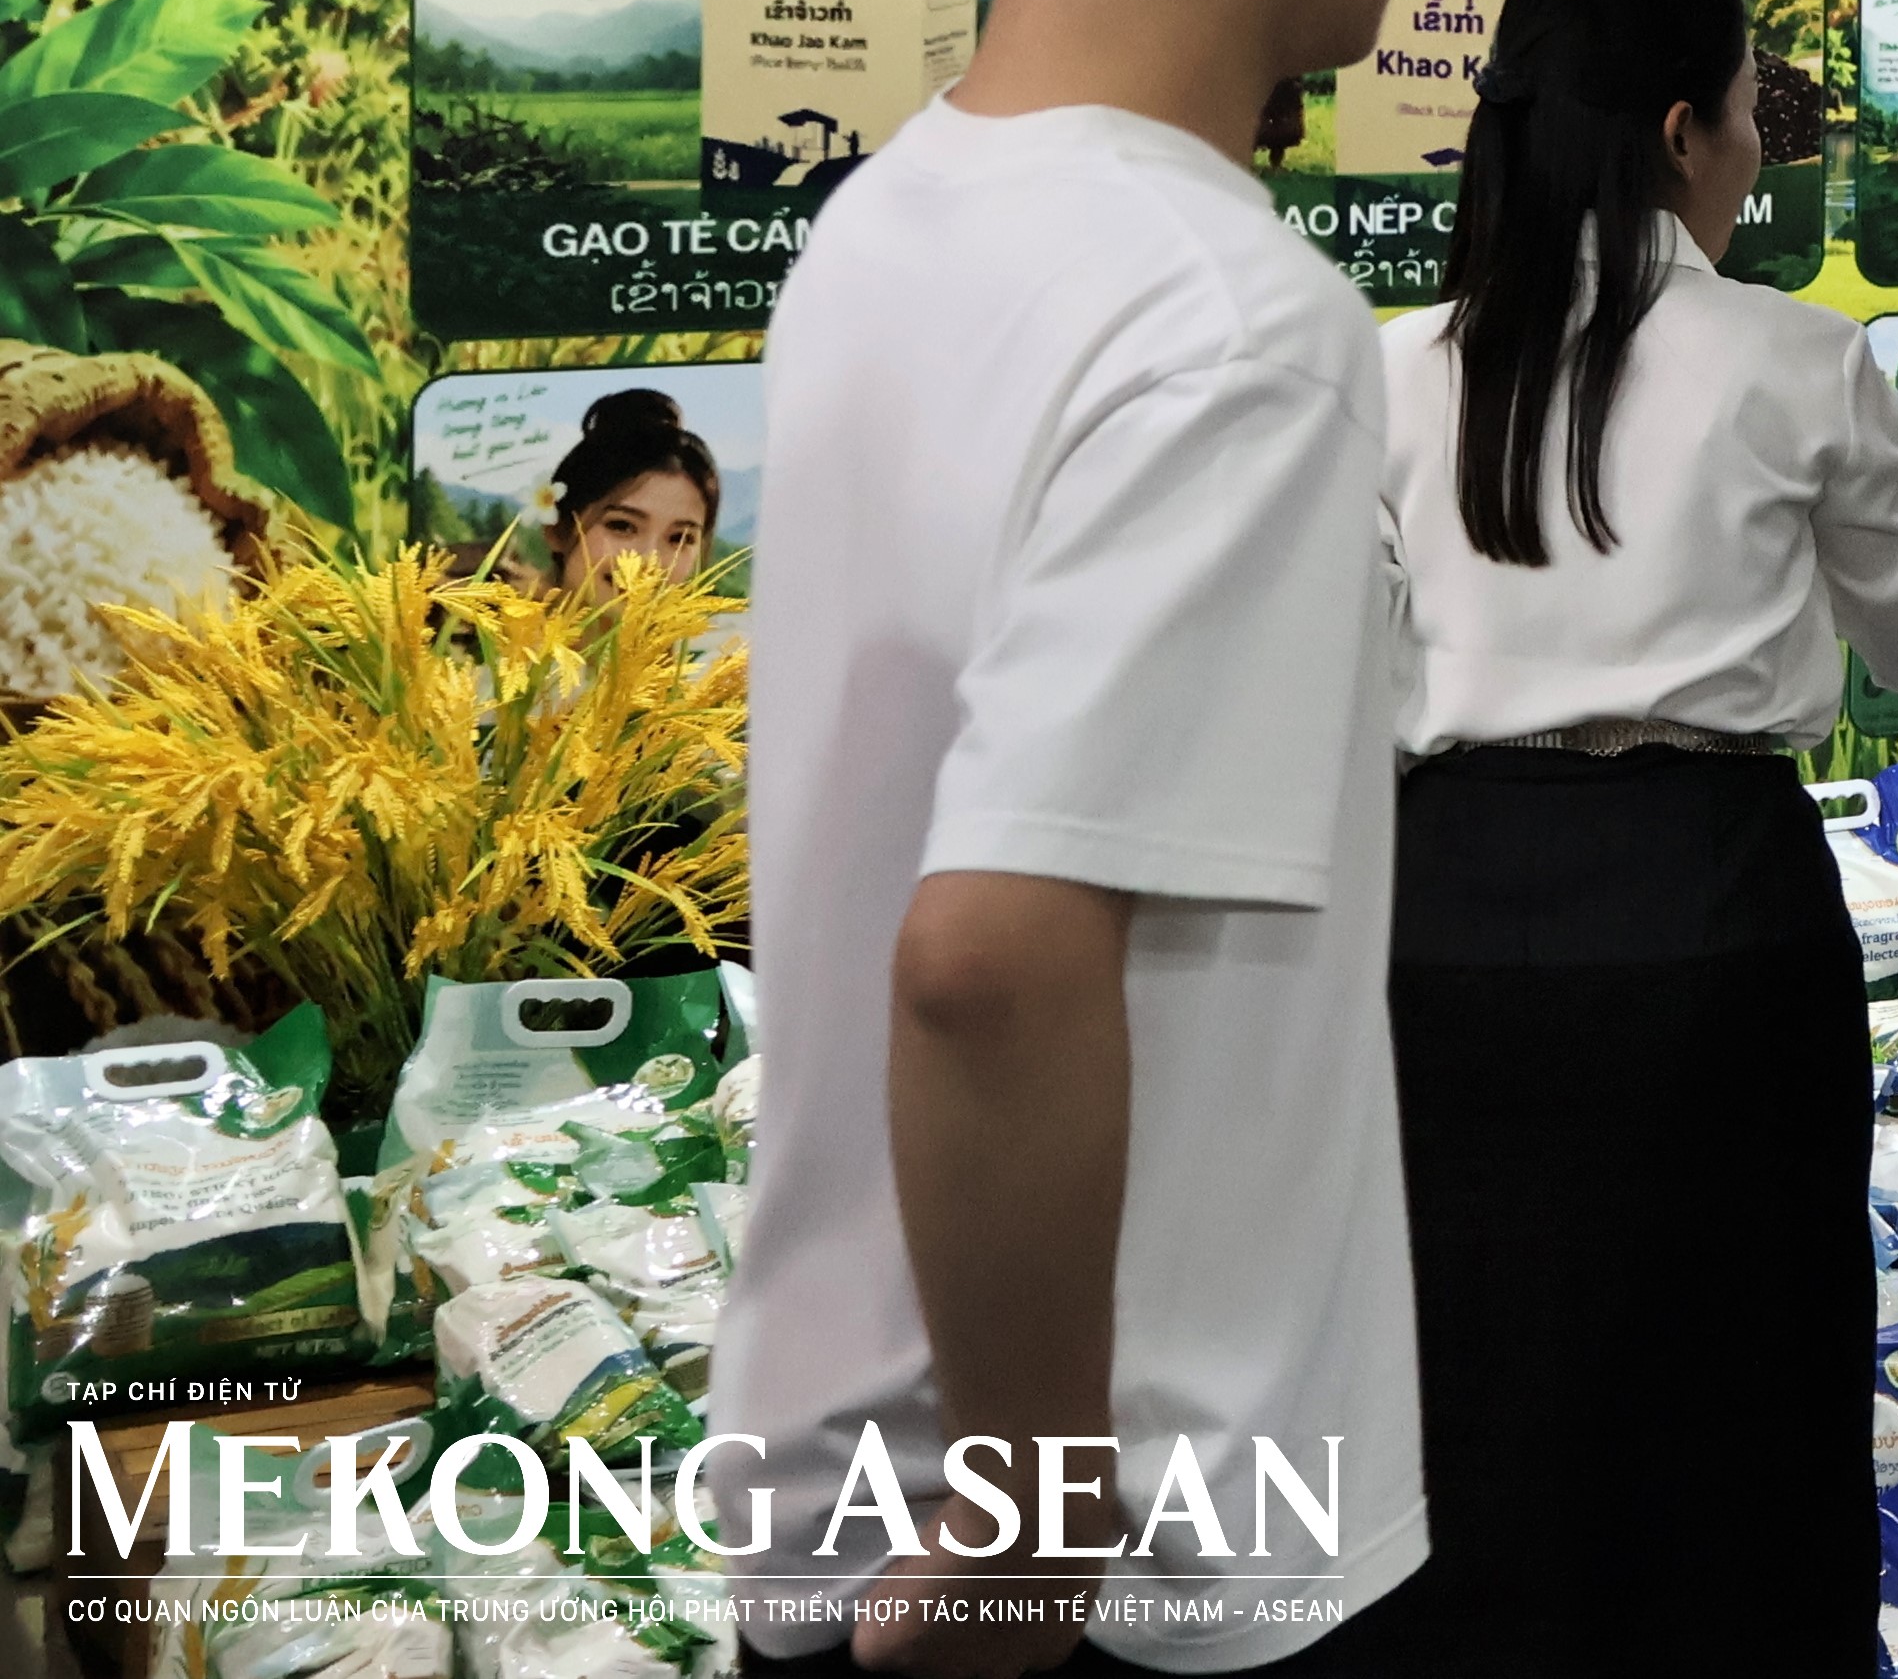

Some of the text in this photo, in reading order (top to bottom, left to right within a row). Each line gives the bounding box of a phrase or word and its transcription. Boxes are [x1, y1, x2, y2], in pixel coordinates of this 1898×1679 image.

[1377, 49, 1453, 79] Khao
[1350, 193, 1423, 236] NẾP
[542, 222, 650, 264] GẠO
